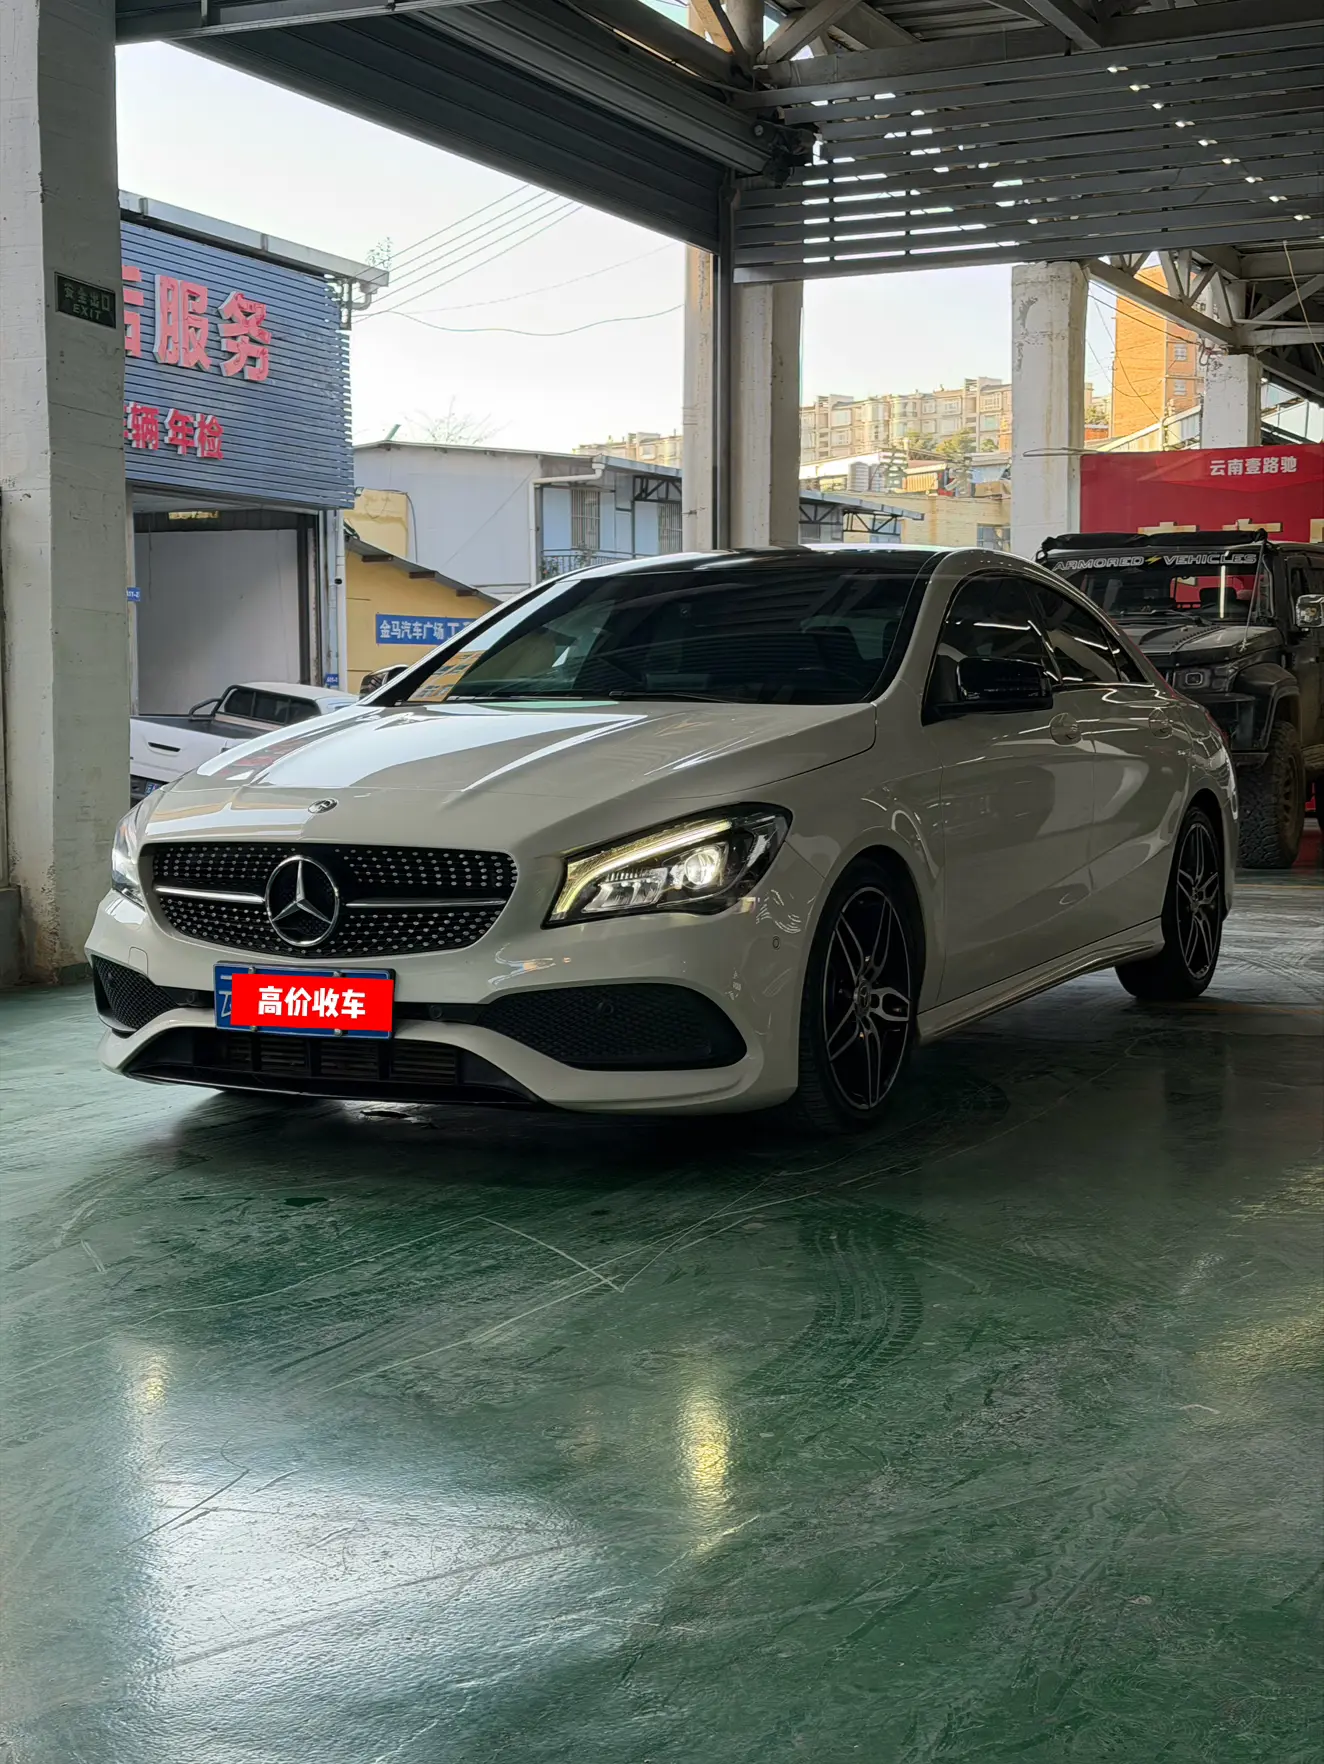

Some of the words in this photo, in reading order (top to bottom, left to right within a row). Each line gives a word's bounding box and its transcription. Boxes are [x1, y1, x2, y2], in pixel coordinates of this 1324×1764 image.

[72, 303, 101, 320] EXIT
[123, 402, 224, 460] 辆年检
[1210, 456, 1297, 476] 云南壹路驰
[1051, 556, 1145, 572] ARMORED
[1163, 553, 1257, 565] VEHICLES
[379, 620, 444, 640] 金马汽车广场
